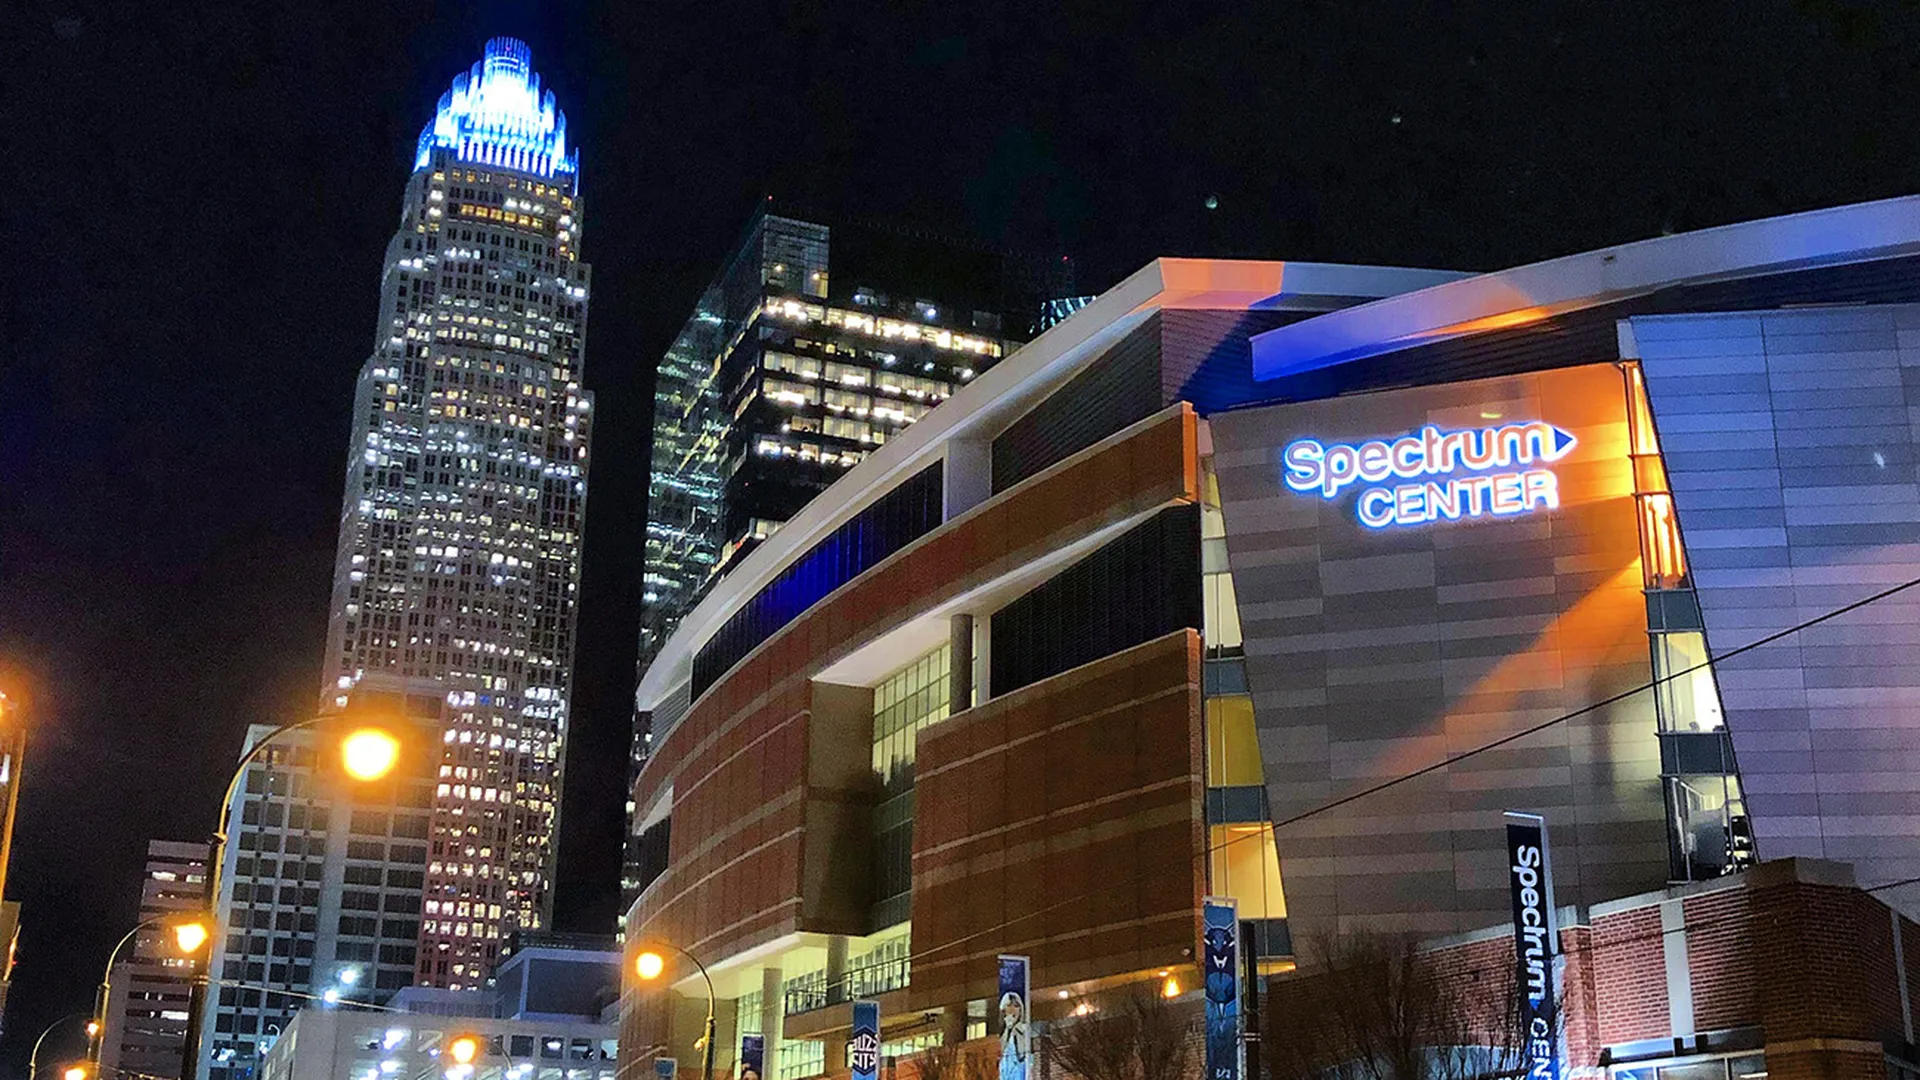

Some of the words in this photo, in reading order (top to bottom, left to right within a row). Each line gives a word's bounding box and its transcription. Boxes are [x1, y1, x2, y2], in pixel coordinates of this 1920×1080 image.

[1285, 422, 1556, 498] Spectrum
[1358, 469, 1561, 528] CENTER
[1512, 844, 1547, 1001] Spectrum
[1530, 1017, 1553, 1080] CEN
